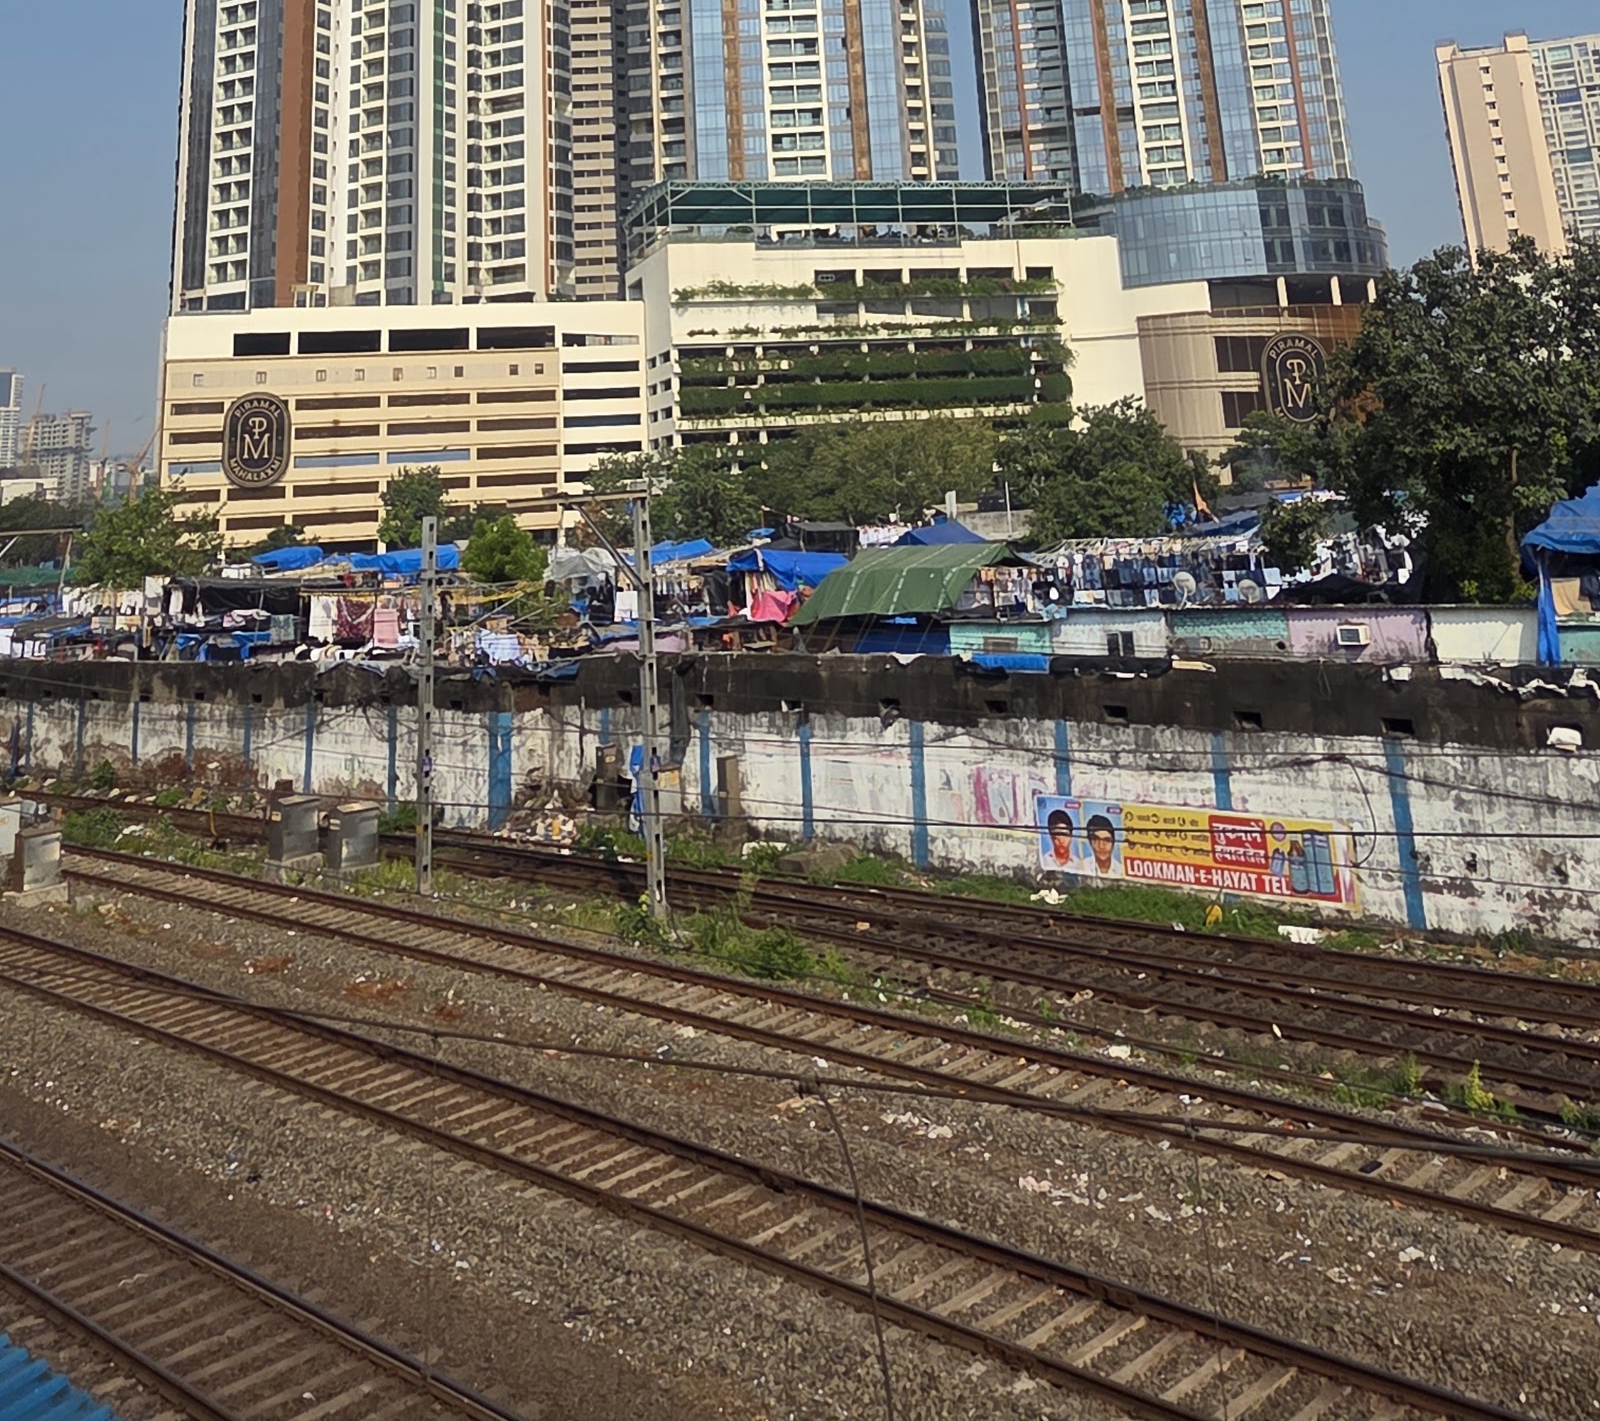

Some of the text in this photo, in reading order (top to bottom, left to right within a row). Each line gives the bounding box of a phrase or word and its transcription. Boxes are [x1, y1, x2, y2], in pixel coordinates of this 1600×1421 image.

[1269, 339, 1318, 359] PIRAMAL
[234, 399, 281, 418] PIRAMAL
[229, 456, 283, 481] MAHALAXMI
[1126, 858, 1292, 895] LOOKMAN-E-HAYAT TEL
